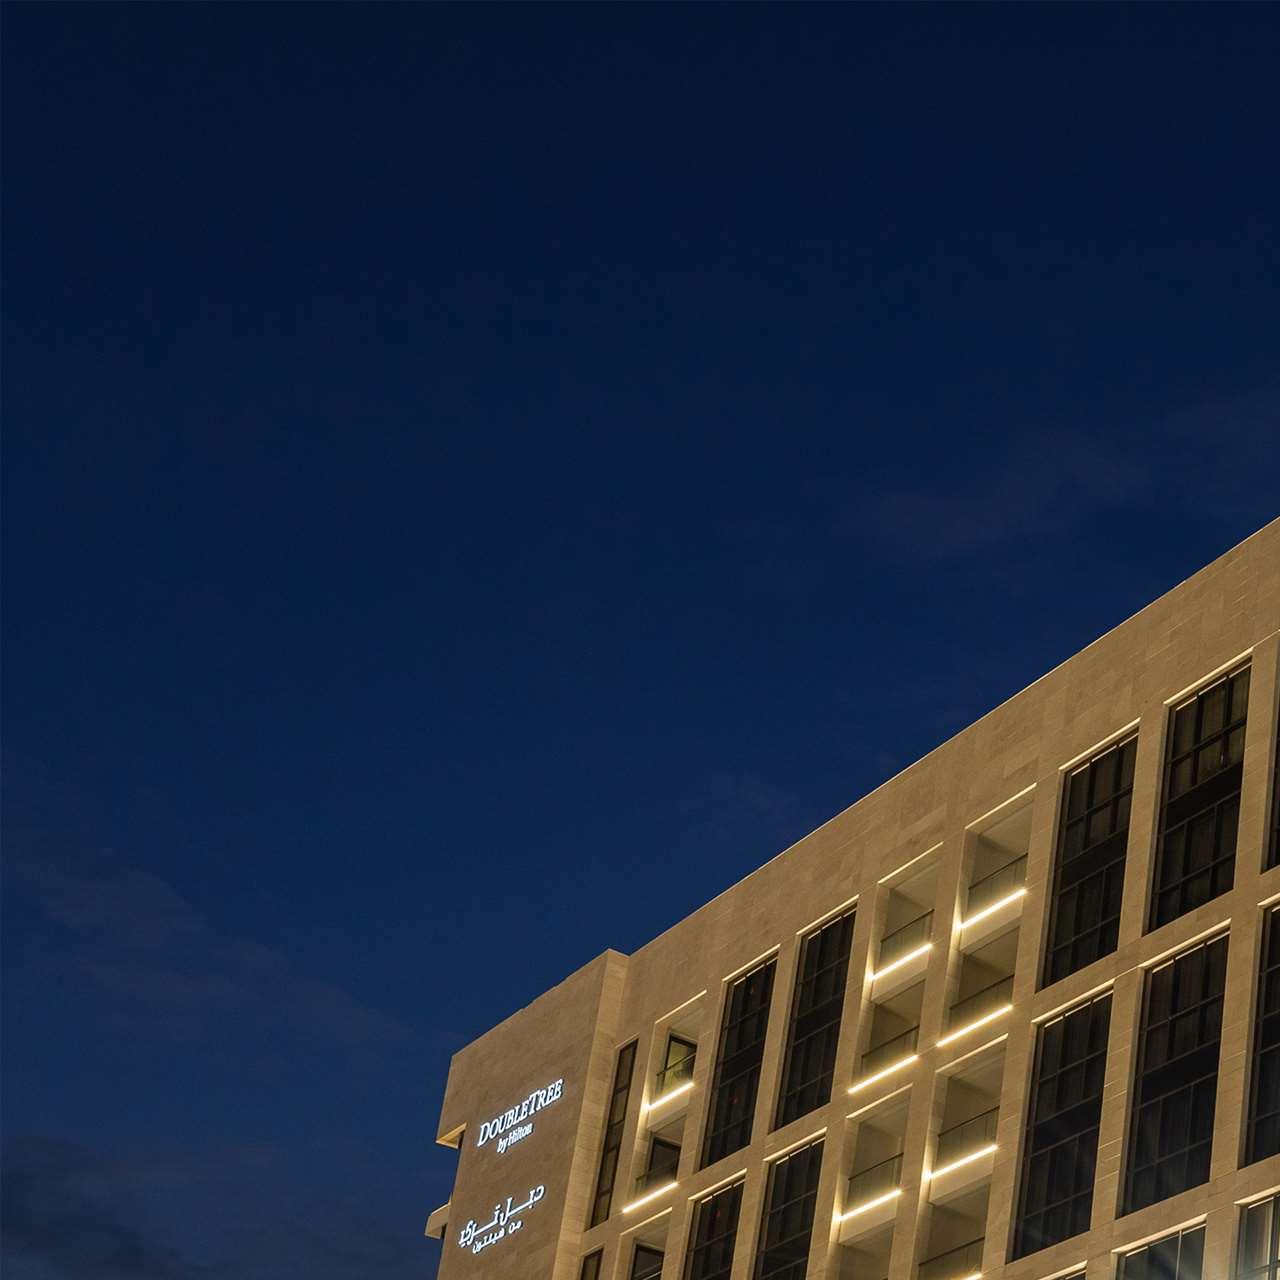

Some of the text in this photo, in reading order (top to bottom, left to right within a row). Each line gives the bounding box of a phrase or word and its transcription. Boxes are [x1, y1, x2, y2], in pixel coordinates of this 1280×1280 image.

[476, 1079, 564, 1147] DOUBLETREE
[497, 1122, 534, 1153] by Hilton
